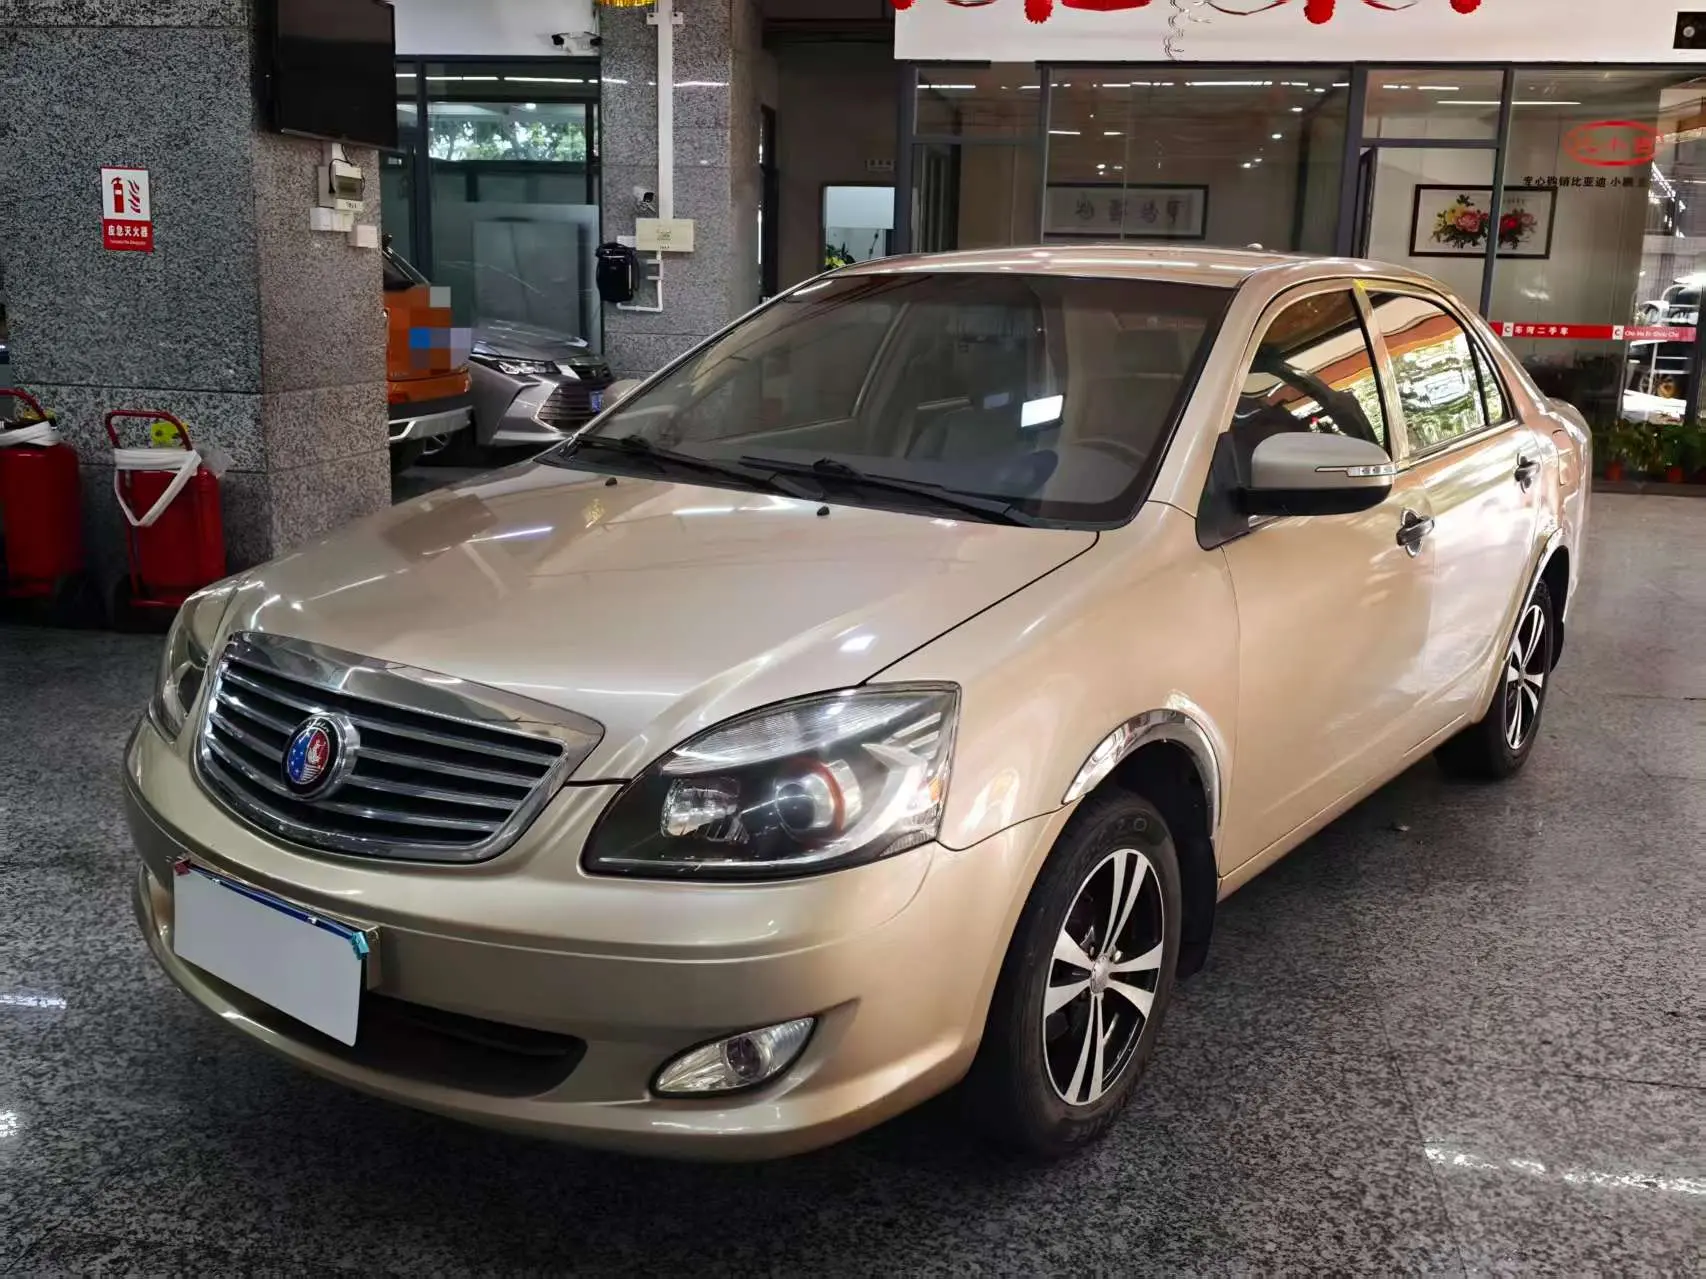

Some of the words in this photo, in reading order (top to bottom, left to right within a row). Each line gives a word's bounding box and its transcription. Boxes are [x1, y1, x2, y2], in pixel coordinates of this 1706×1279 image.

[108, 224, 148, 237] 应急灭火器
